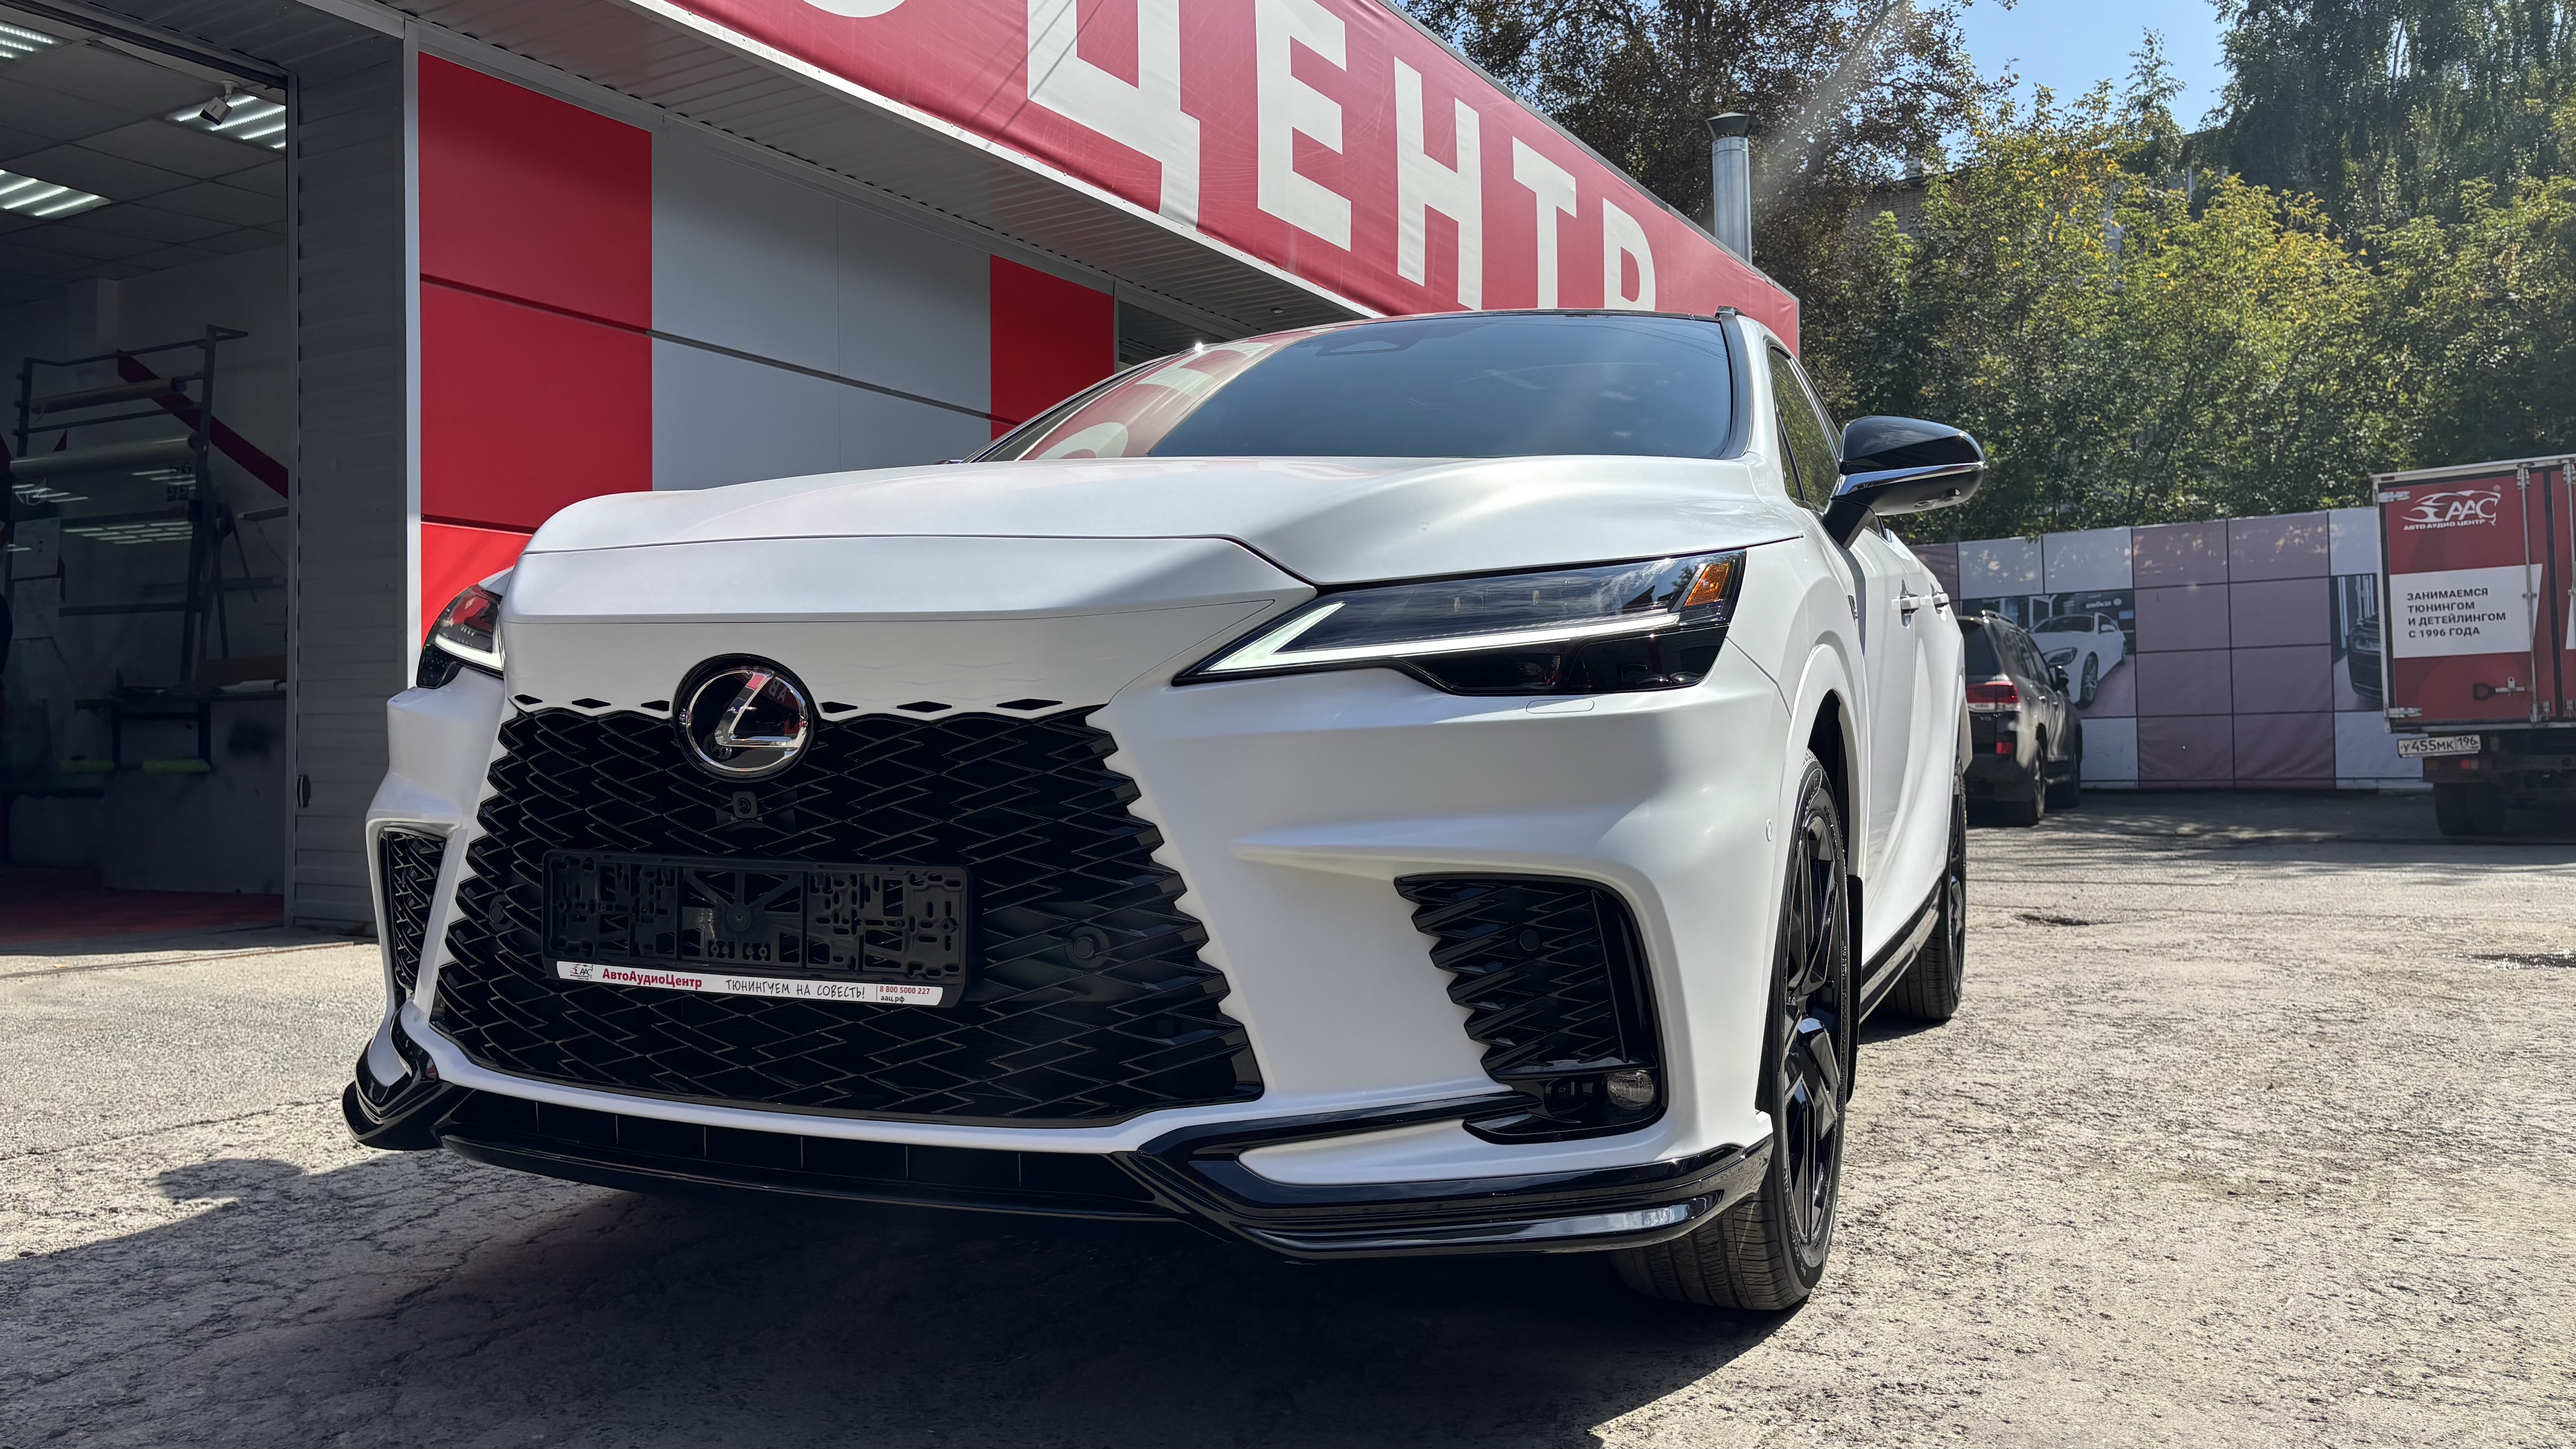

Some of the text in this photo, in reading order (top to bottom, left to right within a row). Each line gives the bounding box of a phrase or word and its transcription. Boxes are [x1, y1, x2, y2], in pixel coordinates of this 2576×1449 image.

[2407, 588, 2488, 601] ЗАНИМАЕМСЯ
[2407, 602, 2475, 613] ТЮНИНГОМ
[2408, 612, 2506, 627] И ДЕТЕЙЛИНГОМ
[2409, 627, 2480, 639] С 1996 ГОДА
[2457, 736, 2476, 748] 196
[603, 968, 702, 990] АвтоАудиоЦентр
[726, 980, 865, 999] ТЮНИНГУЕМ НА СОВЕСТЬ!
[881, 995, 905, 1003] аац.рф
